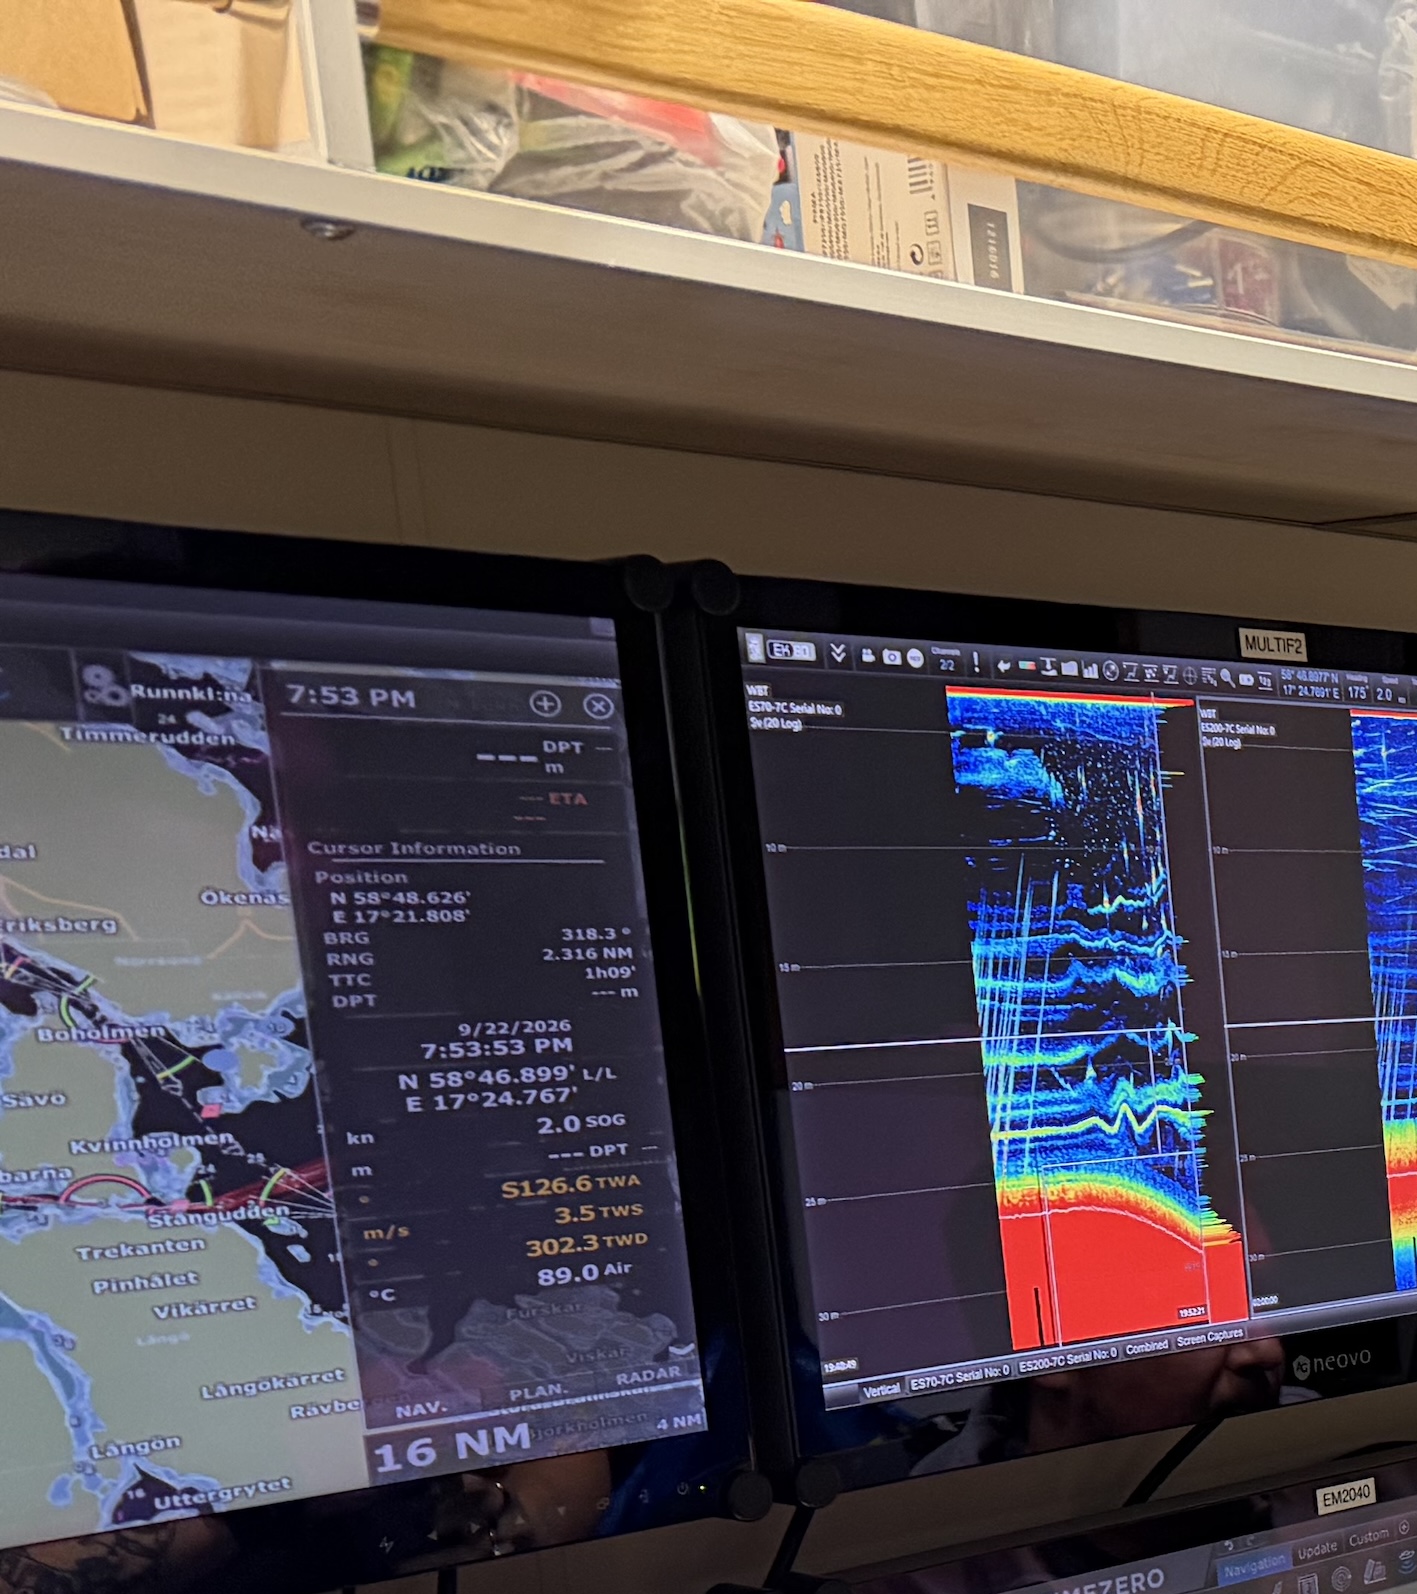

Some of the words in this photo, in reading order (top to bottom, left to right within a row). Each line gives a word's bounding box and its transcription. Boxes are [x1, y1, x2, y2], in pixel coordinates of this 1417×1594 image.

[1245, 634, 1303, 655] MULTIF2
[285, 684, 360, 707] 7:53
[370, 687, 416, 709] PM
[790, 702, 816, 715] Serial
[542, 739, 585, 755] DPT
[548, 792, 589, 806] ETA
[307, 840, 383, 856] Cursor
[390, 841, 522, 857] Information
[315, 870, 409, 885] Position
[331, 892, 347, 905] N
[333, 911, 347, 924] E
[323, 931, 370, 946] BRG
[561, 927, 616, 942] 318.3
[326, 952, 375, 967] RNG
[542, 948, 599, 962] 2.316
[602, 946, 634, 961] NM
[328, 973, 373, 988] TTC
[332, 993, 378, 1009] DPT
[420, 1039, 527, 1060] 7:53:53
[534, 1036, 574, 1054] PM
[398, 1072, 419, 1090] N
[406, 1096, 423, 1113] E
[536, 1114, 582, 1135] 2.0
[585, 1112, 627, 1129] SOG
[346, 1130, 375, 1146] kn
[589, 1142, 629, 1159] DPT
[501, 1174, 593, 1200] S126.6
[595, 1173, 642, 1190] TWA
[554, 1204, 596, 1225] 3.5
[599, 1203, 645, 1219] TWS
[362, 1224, 410, 1241] m/s
[75, 1236, 207, 1262] Trekanten
[526, 1232, 600, 1258] 302.3
[602, 1231, 649, 1248] TWD
[537, 1263, 600, 1287] 89.0
[603, 1260, 633, 1276] Air
[1125, 1338, 1169, 1356] Combined
[1176, 1330, 1207, 1347] Screen
[1207, 1326, 1244, 1344] Captures
[1066, 1350, 1092, 1366] Serial
[1110, 1346, 1118, 1359] 0
[1312, 1348, 1372, 1374] neovo
[614, 1365, 682, 1386] RADAR
[863, 1382, 901, 1399] Vertical
[910, 1372, 955, 1391] ES70-7C
[955, 1368, 983, 1384] Serial
[1002, 1364, 1010, 1376] 0
[672, 1413, 702, 1430] NM
[374, 1437, 438, 1474] 16
[455, 1422, 532, 1460] NM
[1322, 1483, 1371, 1507] EM2040
[1347, 1527, 1390, 1548] Custom
[1297, 1539, 1339, 1561] Update
[1223, 1552, 1287, 1578] Navigation
